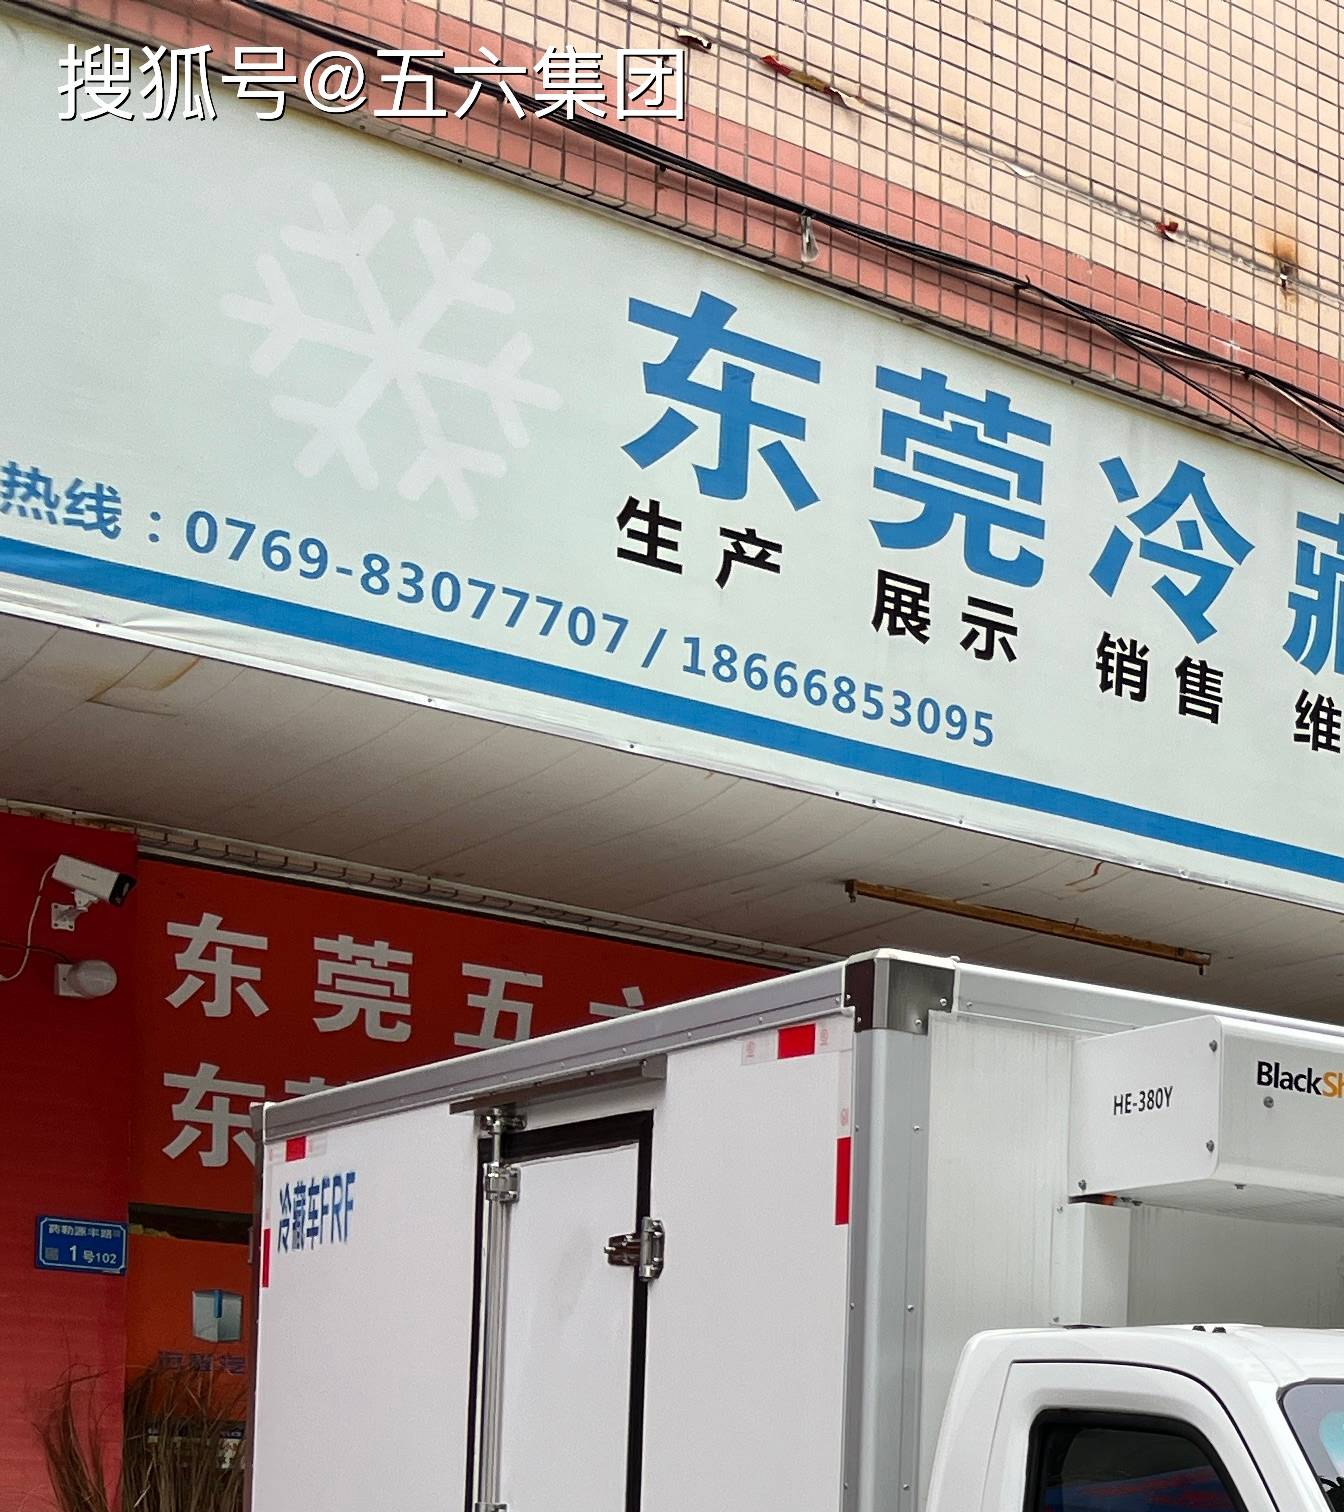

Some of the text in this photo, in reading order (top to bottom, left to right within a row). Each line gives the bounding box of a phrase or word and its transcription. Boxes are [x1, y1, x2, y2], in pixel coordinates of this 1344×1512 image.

[616, 498, 783, 588] 生产
[871, 569, 1018, 664] 展示
[1096, 631, 1226, 725] 销售
[1113, 1085, 1174, 1116] HE-380Y
[278, 1171, 356, 1254] 冷藏车FRF
